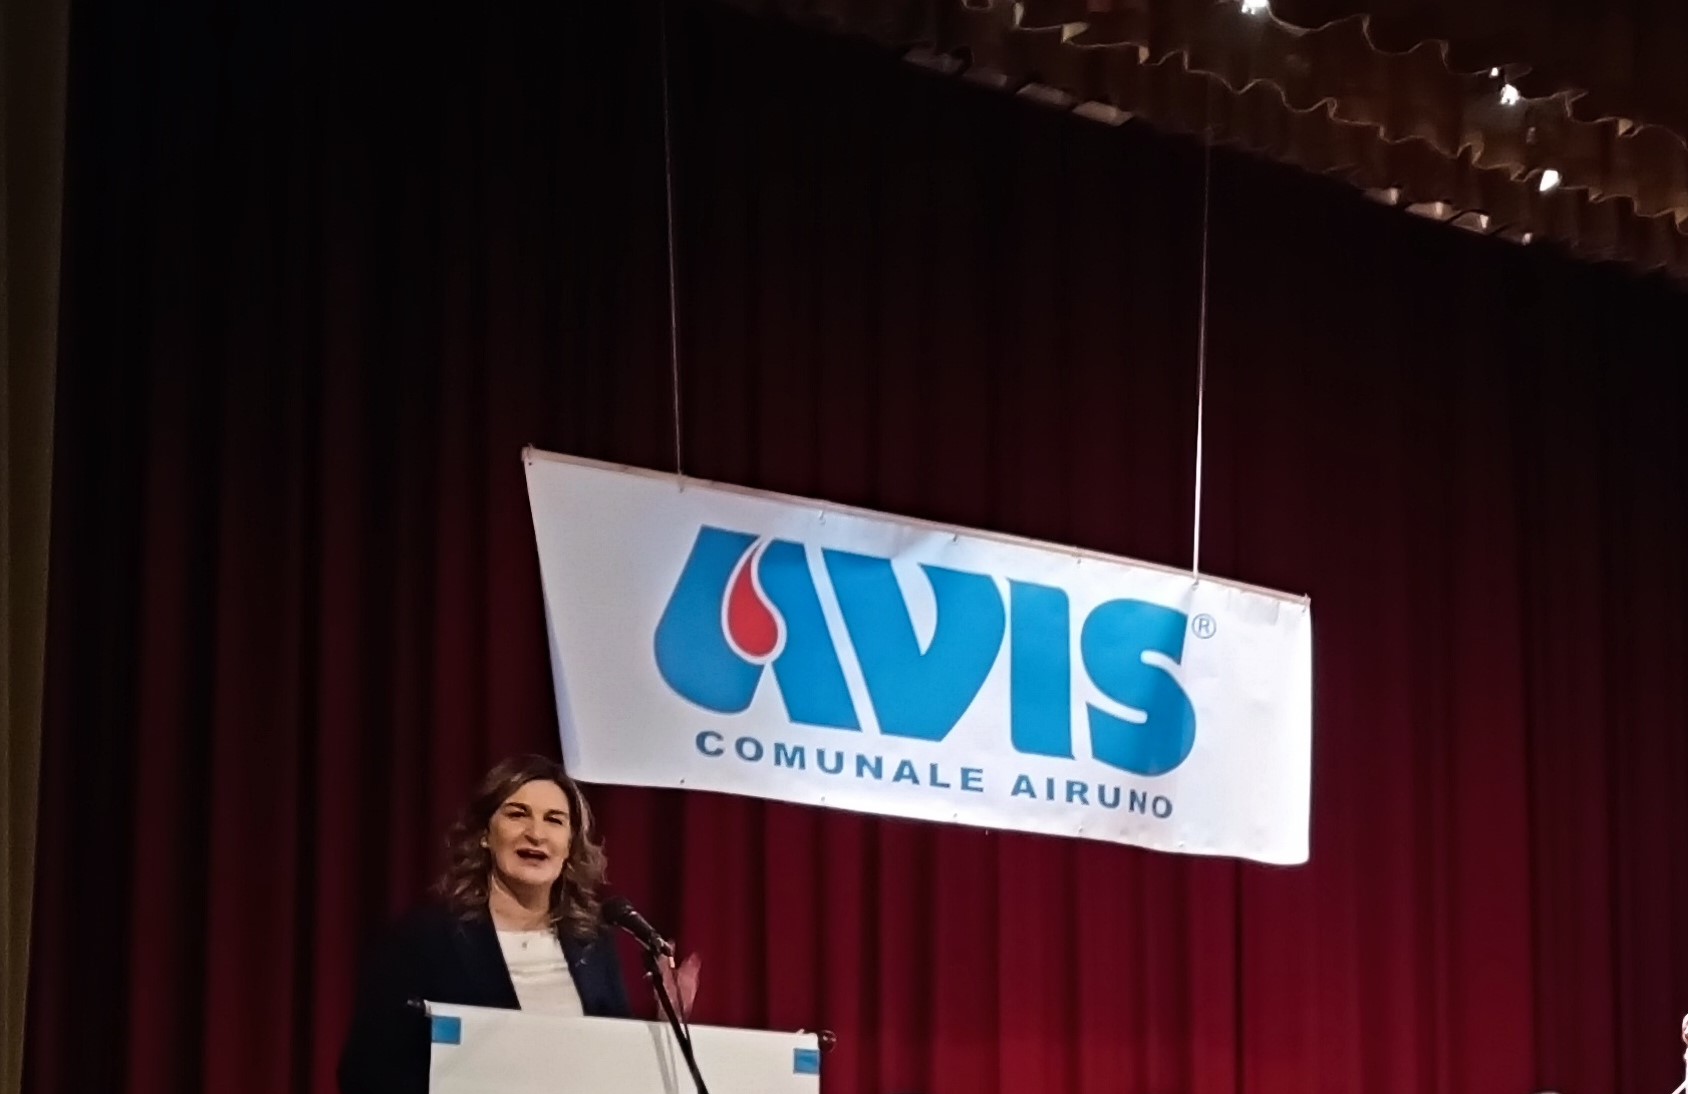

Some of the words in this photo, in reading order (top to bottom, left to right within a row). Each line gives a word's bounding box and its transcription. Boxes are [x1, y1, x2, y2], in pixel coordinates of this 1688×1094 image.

[654, 525, 1196, 776] AVIS
[696, 731, 985, 793] COMUNALE
[1012, 773, 1175, 819] AIRUNO
